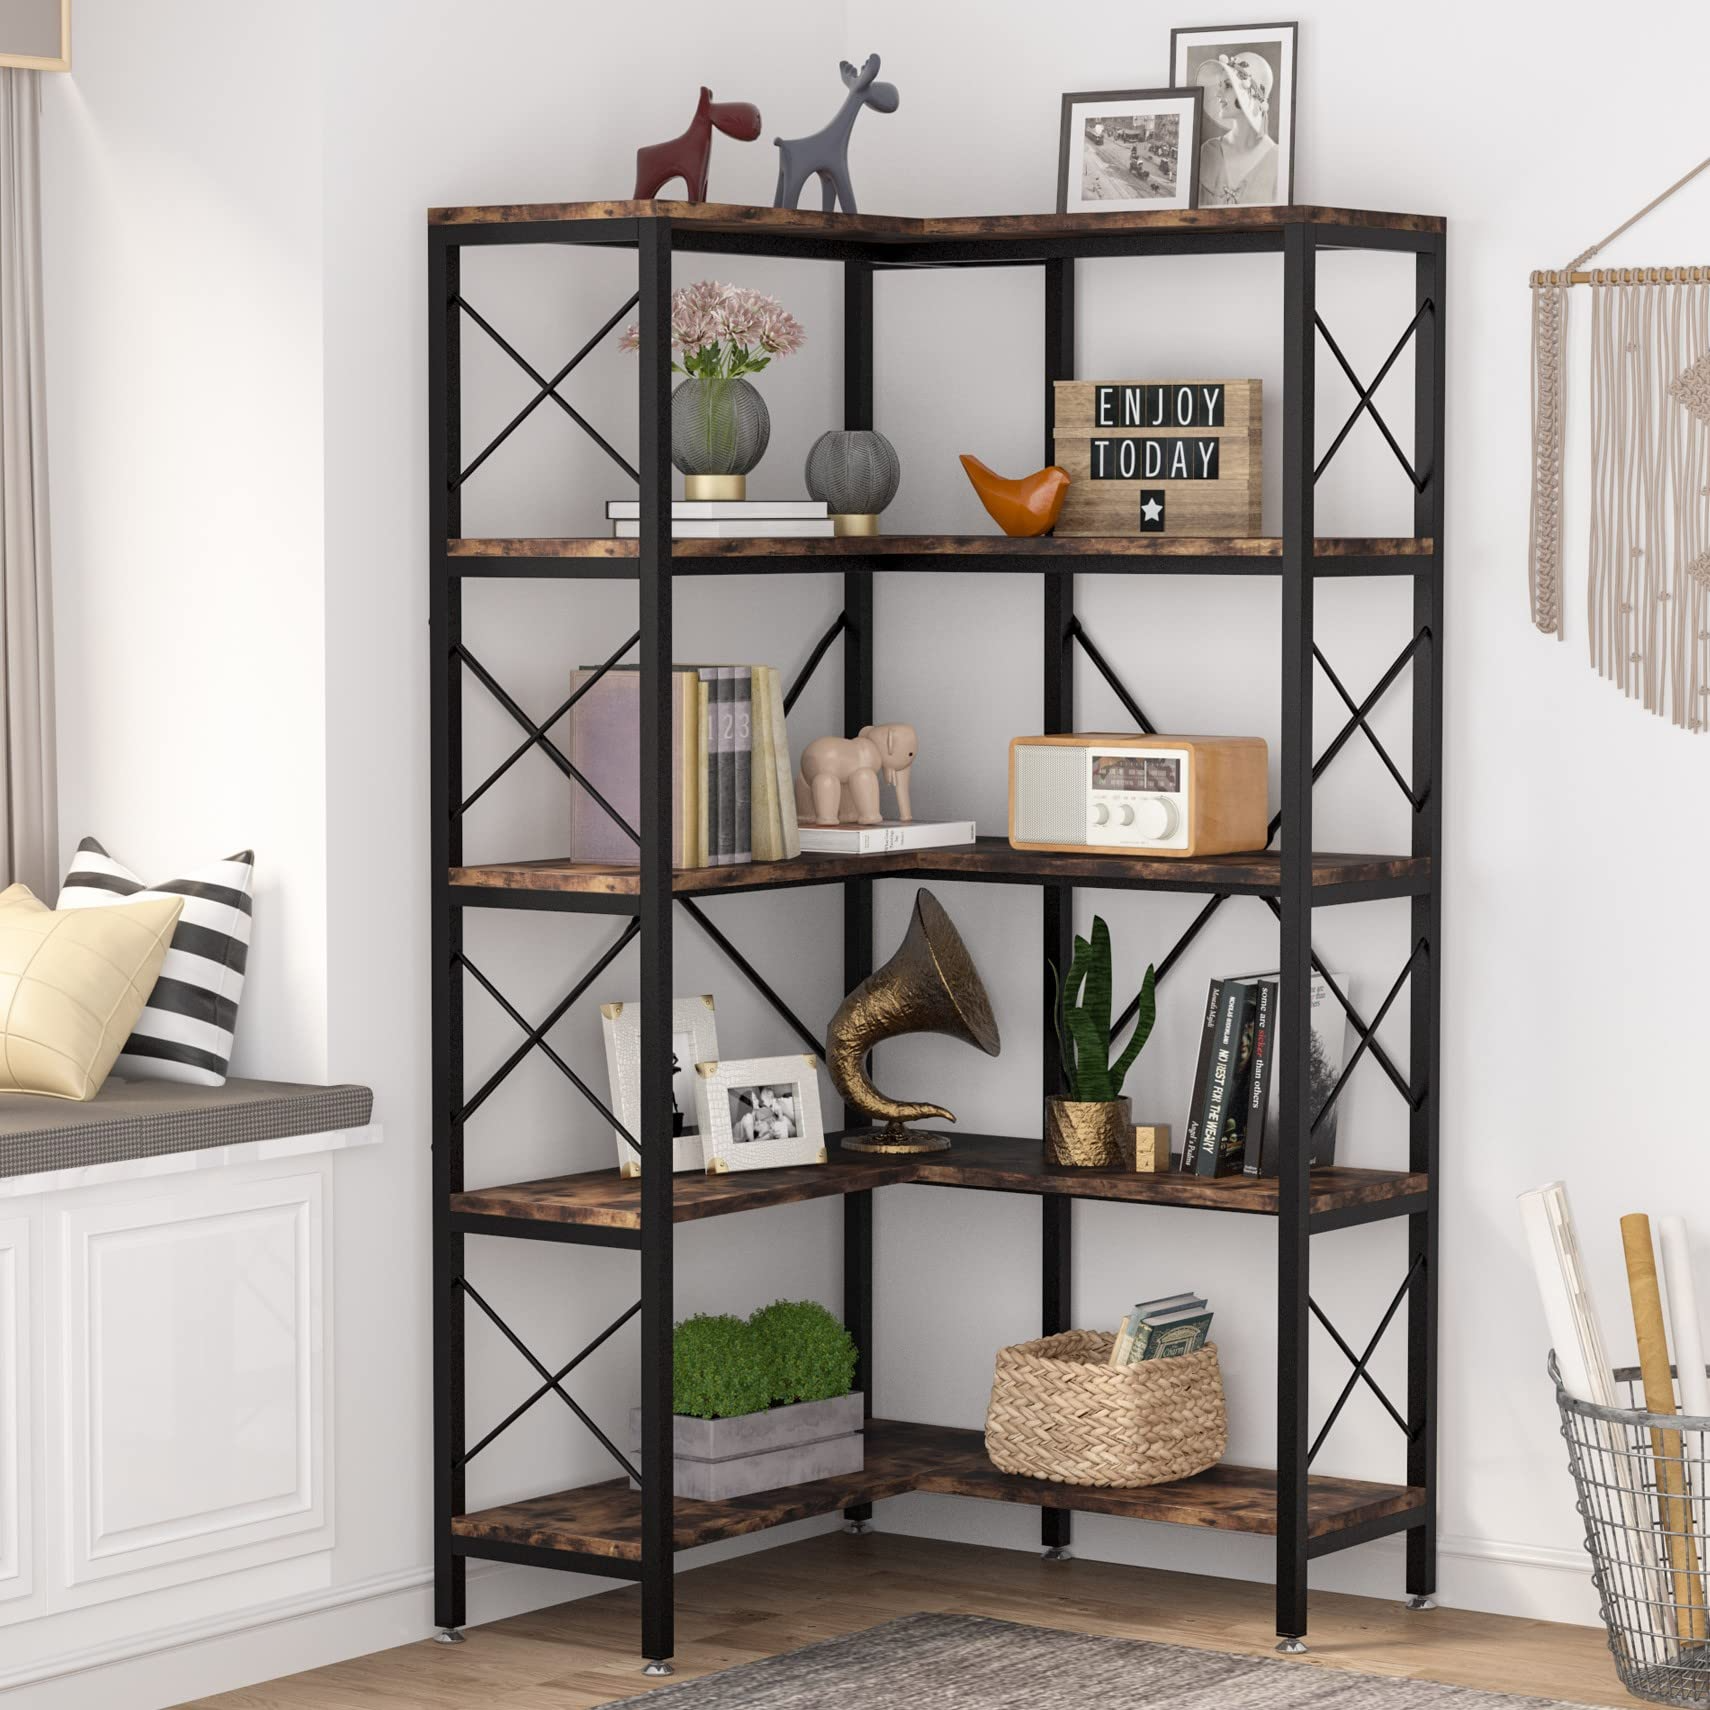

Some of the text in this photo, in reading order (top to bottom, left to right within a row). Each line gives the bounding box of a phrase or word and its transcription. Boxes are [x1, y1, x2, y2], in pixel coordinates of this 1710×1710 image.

[1100, 387, 1219, 426] ENJOY
[1094, 440, 1215, 478] TODAY
[722, 713, 733, 739] 2
[740, 713, 750, 738] 3
[1260, 987, 1268, 1011] some
[1257, 1030, 1265, 1057] sicker
[1255, 1060, 1263, 1079] than
[1202, 1048, 1230, 1154] NO REST FOR THE WEARY
[1253, 1080, 1262, 1109] others
